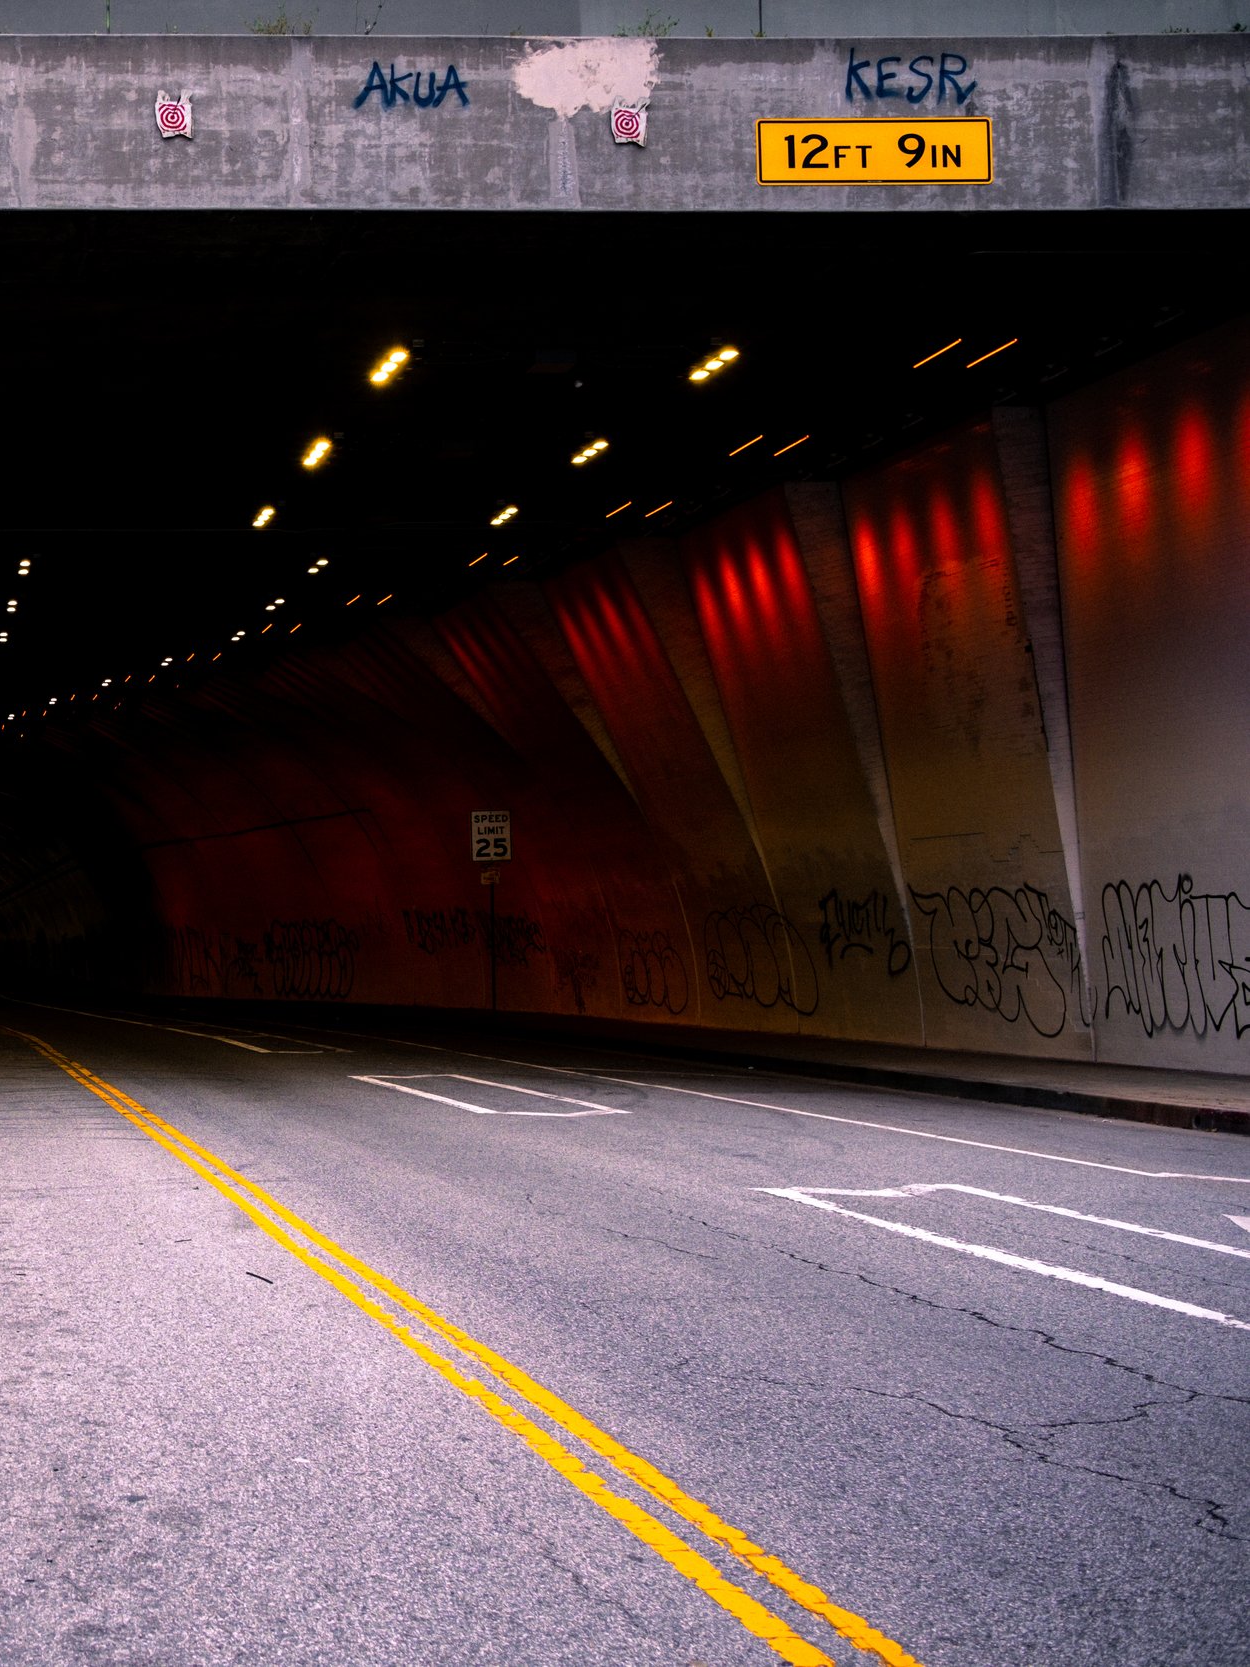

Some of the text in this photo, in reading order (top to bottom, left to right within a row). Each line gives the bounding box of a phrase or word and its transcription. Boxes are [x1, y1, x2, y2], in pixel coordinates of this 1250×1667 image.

[353, 61, 470, 109] AKUA
[897, 133, 962, 169] 9IN
[474, 814, 508, 823] SPEED
[477, 826, 505, 835] LIMIT
[476, 838, 508, 857] 25
